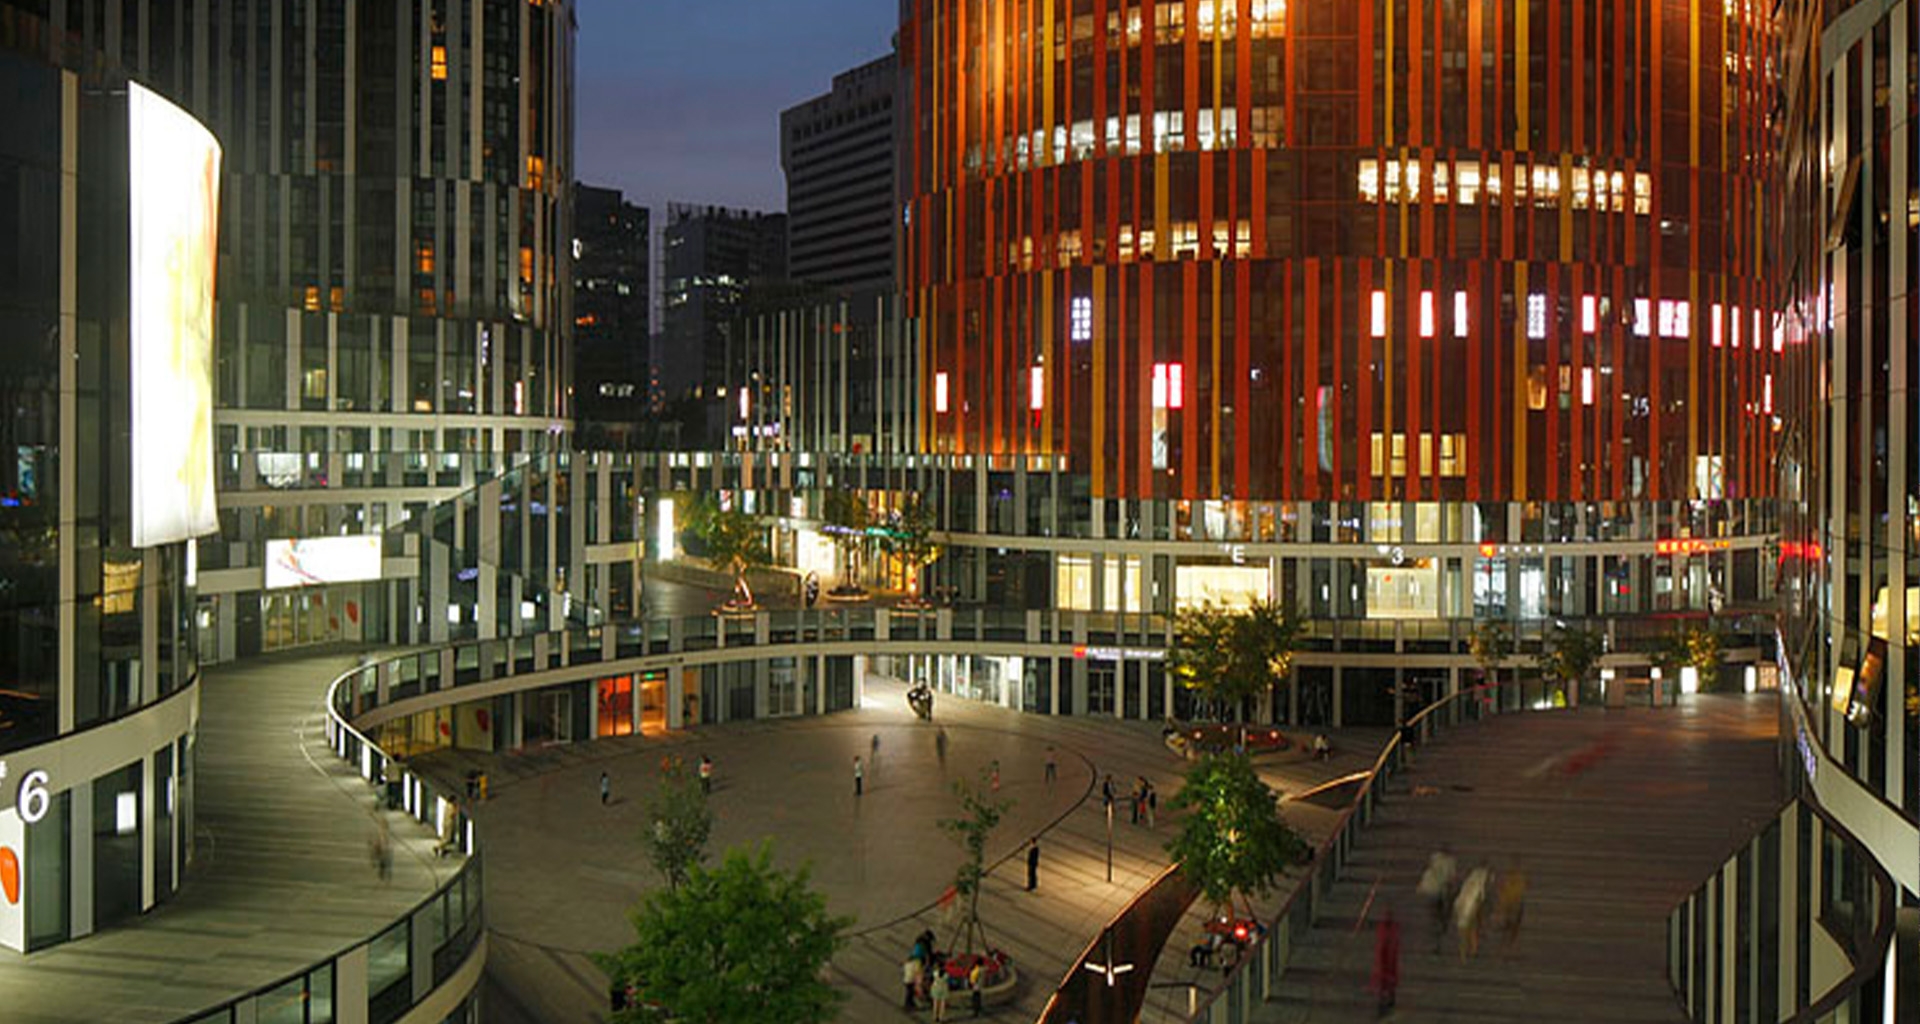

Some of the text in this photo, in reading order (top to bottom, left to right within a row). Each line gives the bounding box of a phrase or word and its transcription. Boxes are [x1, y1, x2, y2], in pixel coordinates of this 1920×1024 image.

[1232, 545, 1246, 564] E
[1391, 547, 1405, 566] 3
[19, 769, 49, 823] 6
